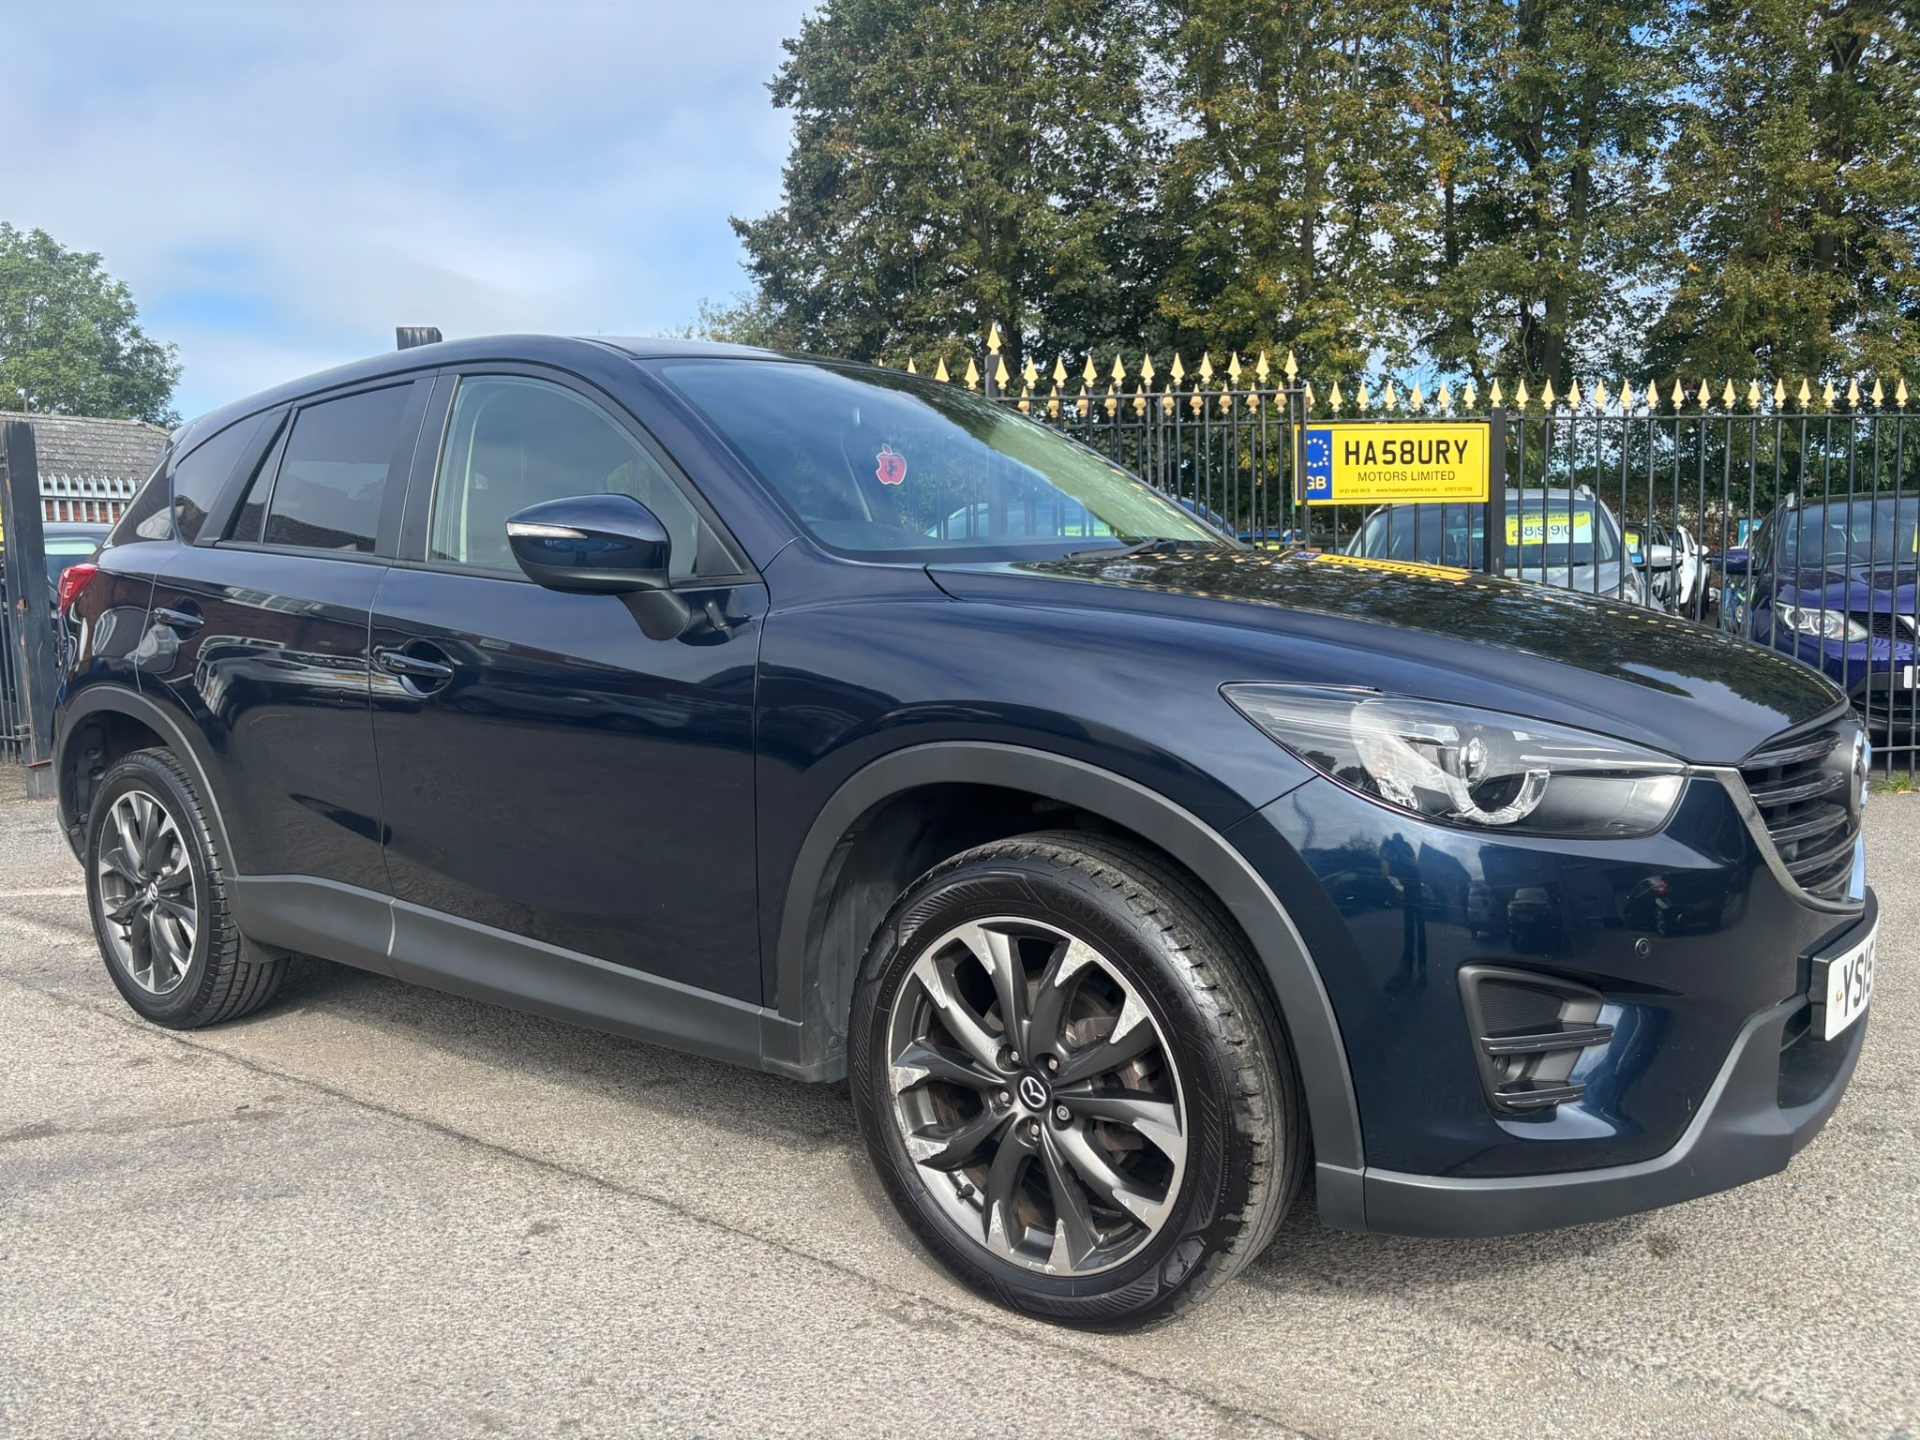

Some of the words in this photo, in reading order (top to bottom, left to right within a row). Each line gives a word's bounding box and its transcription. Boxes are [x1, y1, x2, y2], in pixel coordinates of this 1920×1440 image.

[1306, 475, 1327, 490] GB
[1357, 471, 1408, 482] MOTORS
[1411, 470, 1456, 481] LIMITED
